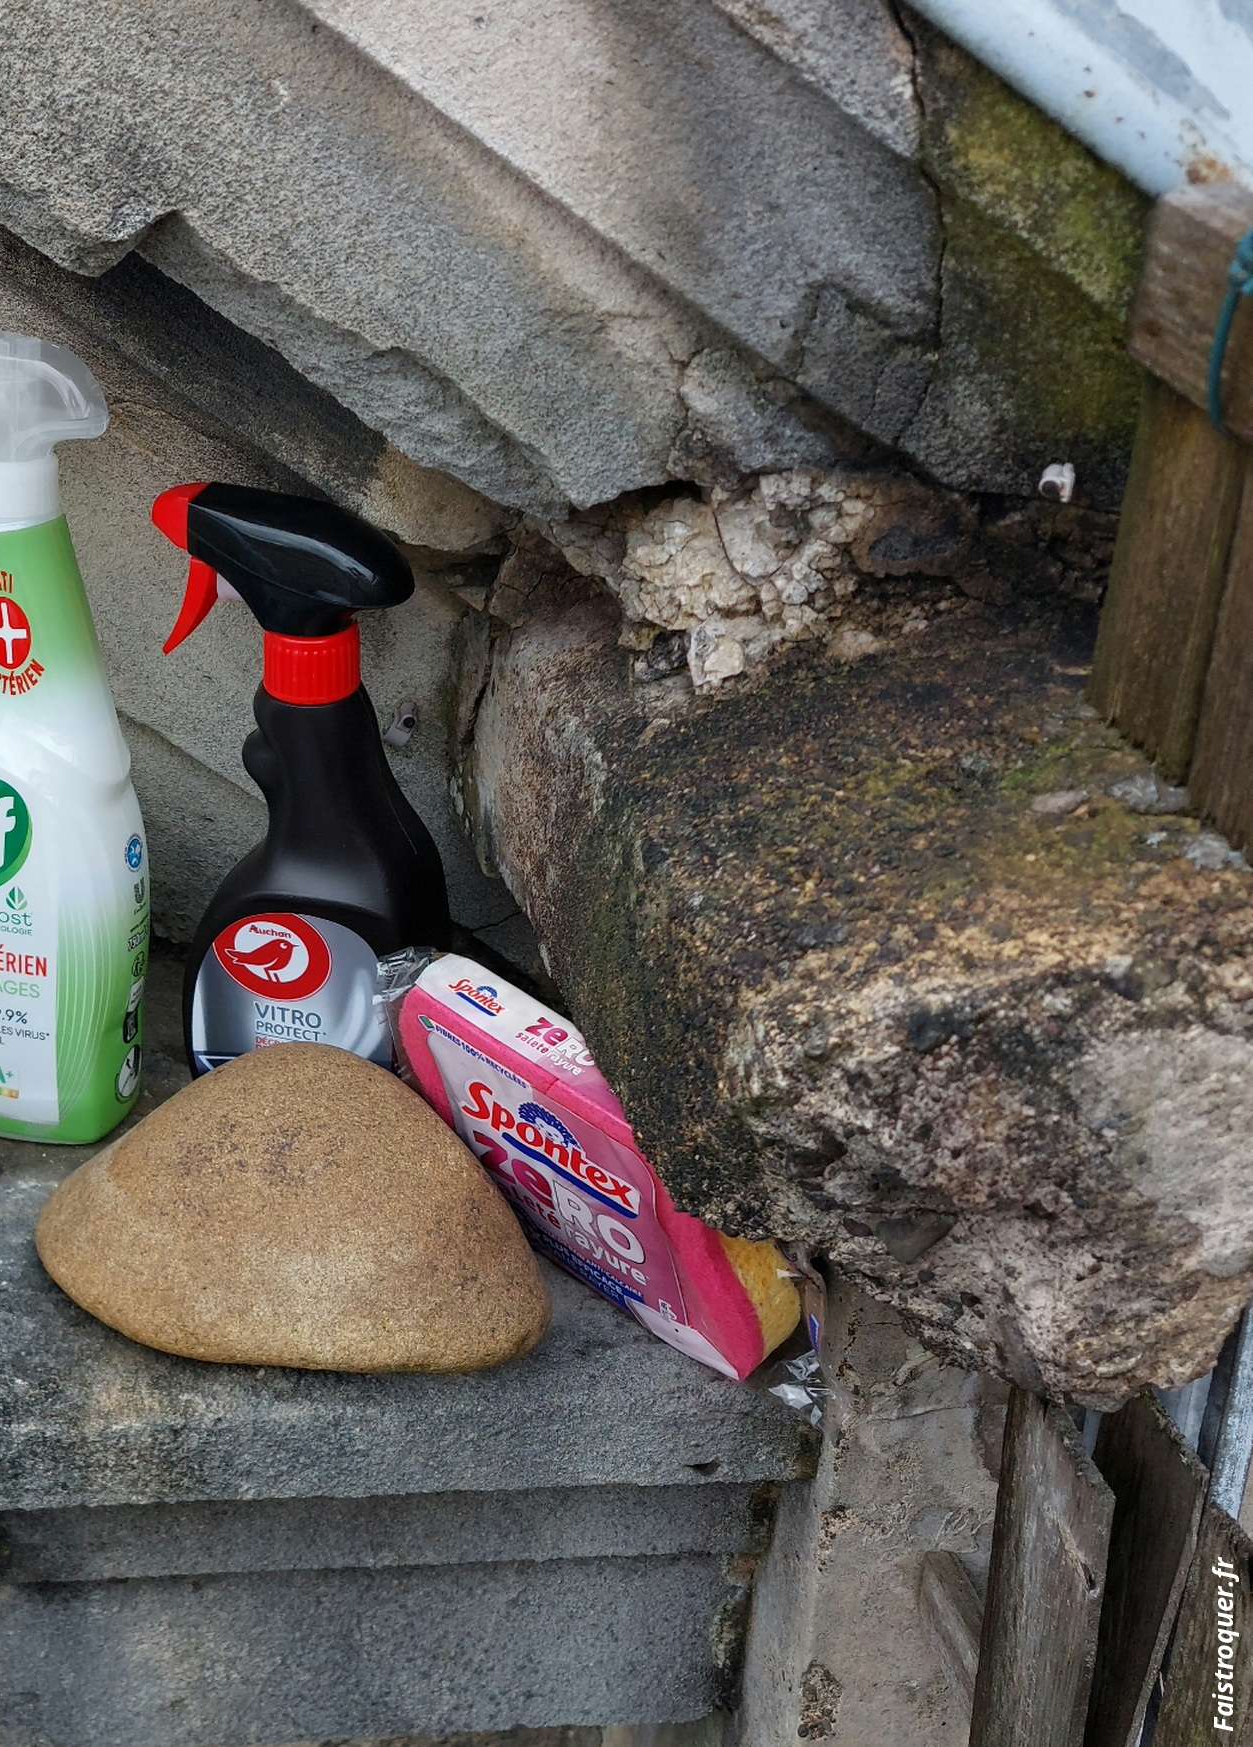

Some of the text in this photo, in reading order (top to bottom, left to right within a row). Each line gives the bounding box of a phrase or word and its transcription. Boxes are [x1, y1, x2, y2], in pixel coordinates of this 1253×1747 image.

[249, 924, 292, 939] Auchan
[448, 978, 505, 1014] Spontex
[254, 1002, 322, 1029] VITRO
[256, 1020, 321, 1042] PROTECT
[462, 1081, 635, 1210] Spontex
